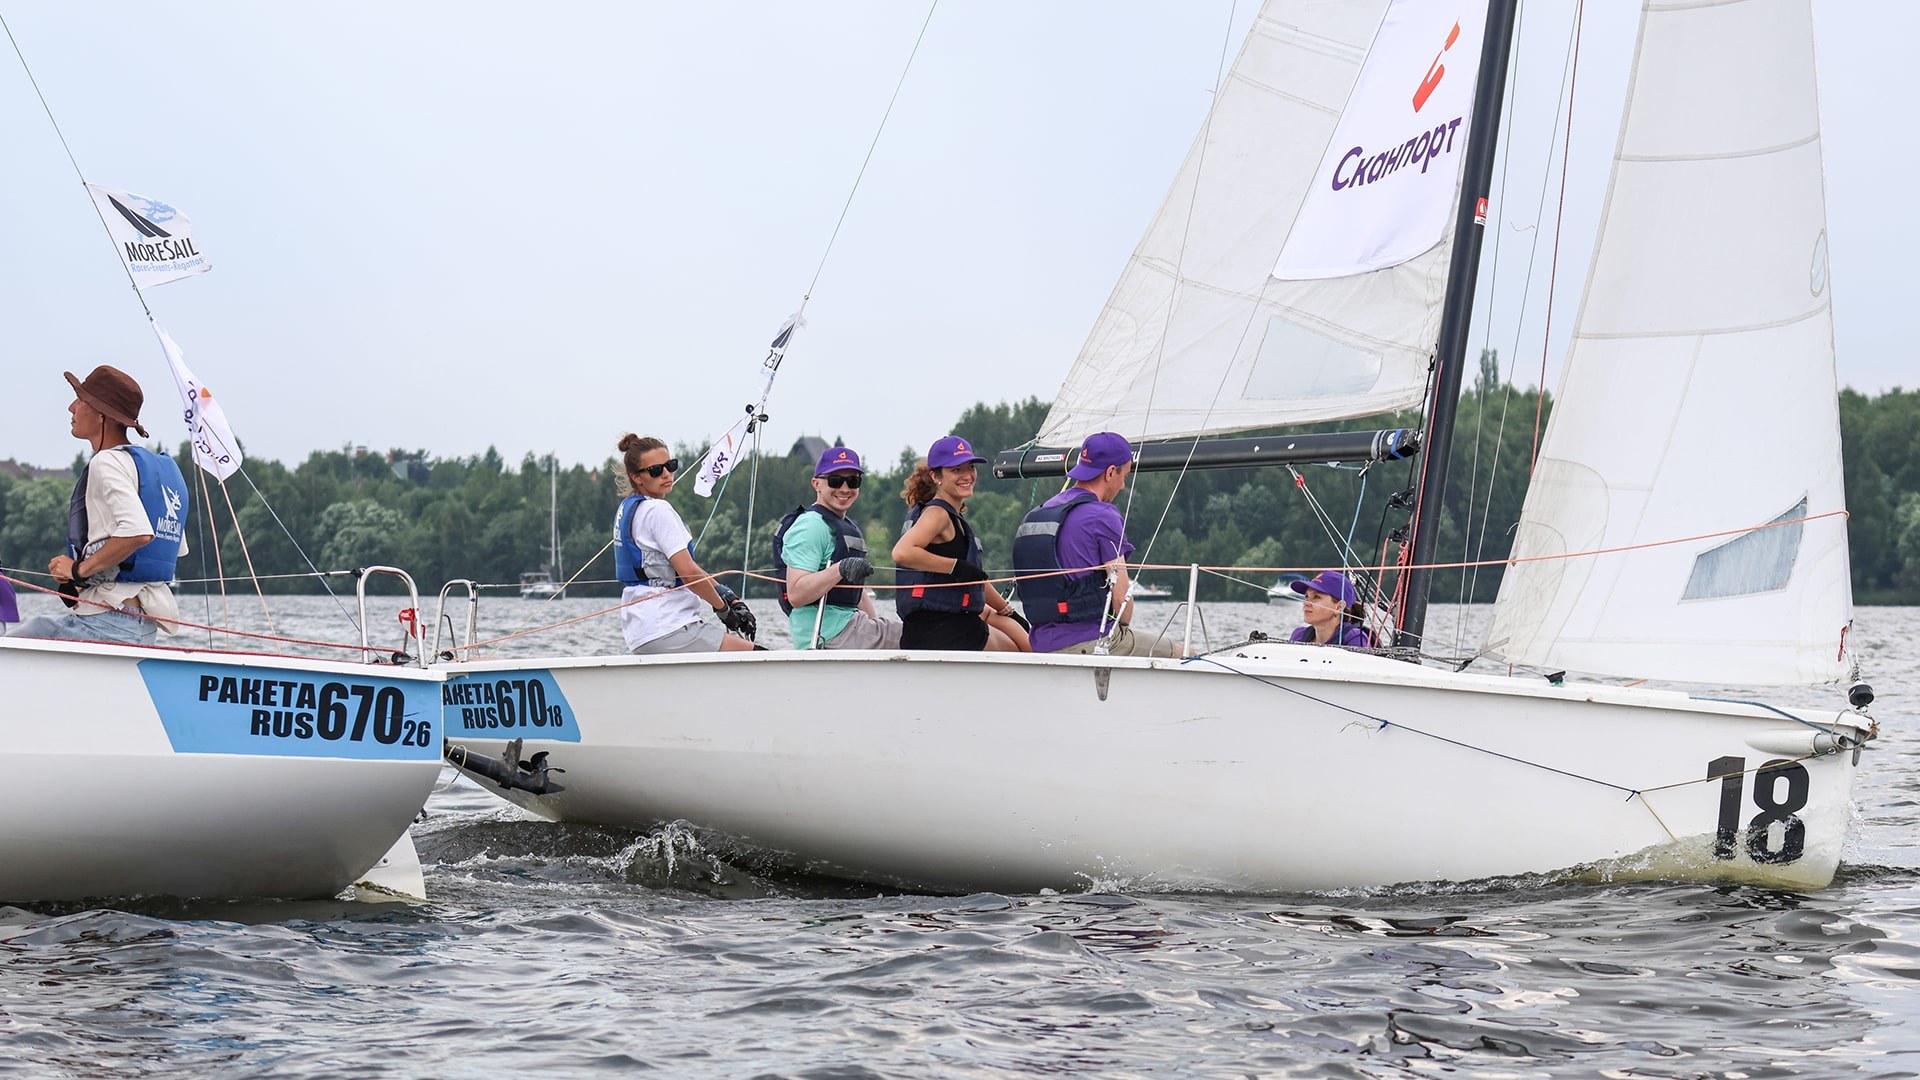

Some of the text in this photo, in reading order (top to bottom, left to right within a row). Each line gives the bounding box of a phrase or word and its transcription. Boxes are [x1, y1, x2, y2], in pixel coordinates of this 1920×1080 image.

[1331, 116, 1462, 191] Сканпорт
[124, 237, 199, 262] MORESAIL
[250, 709, 314, 739] RUS
[316, 682, 431, 748] 670 26
[462, 707, 499, 730] RUS
[495, 679, 563, 729] 670 18
[1706, 755, 1810, 865] 18
